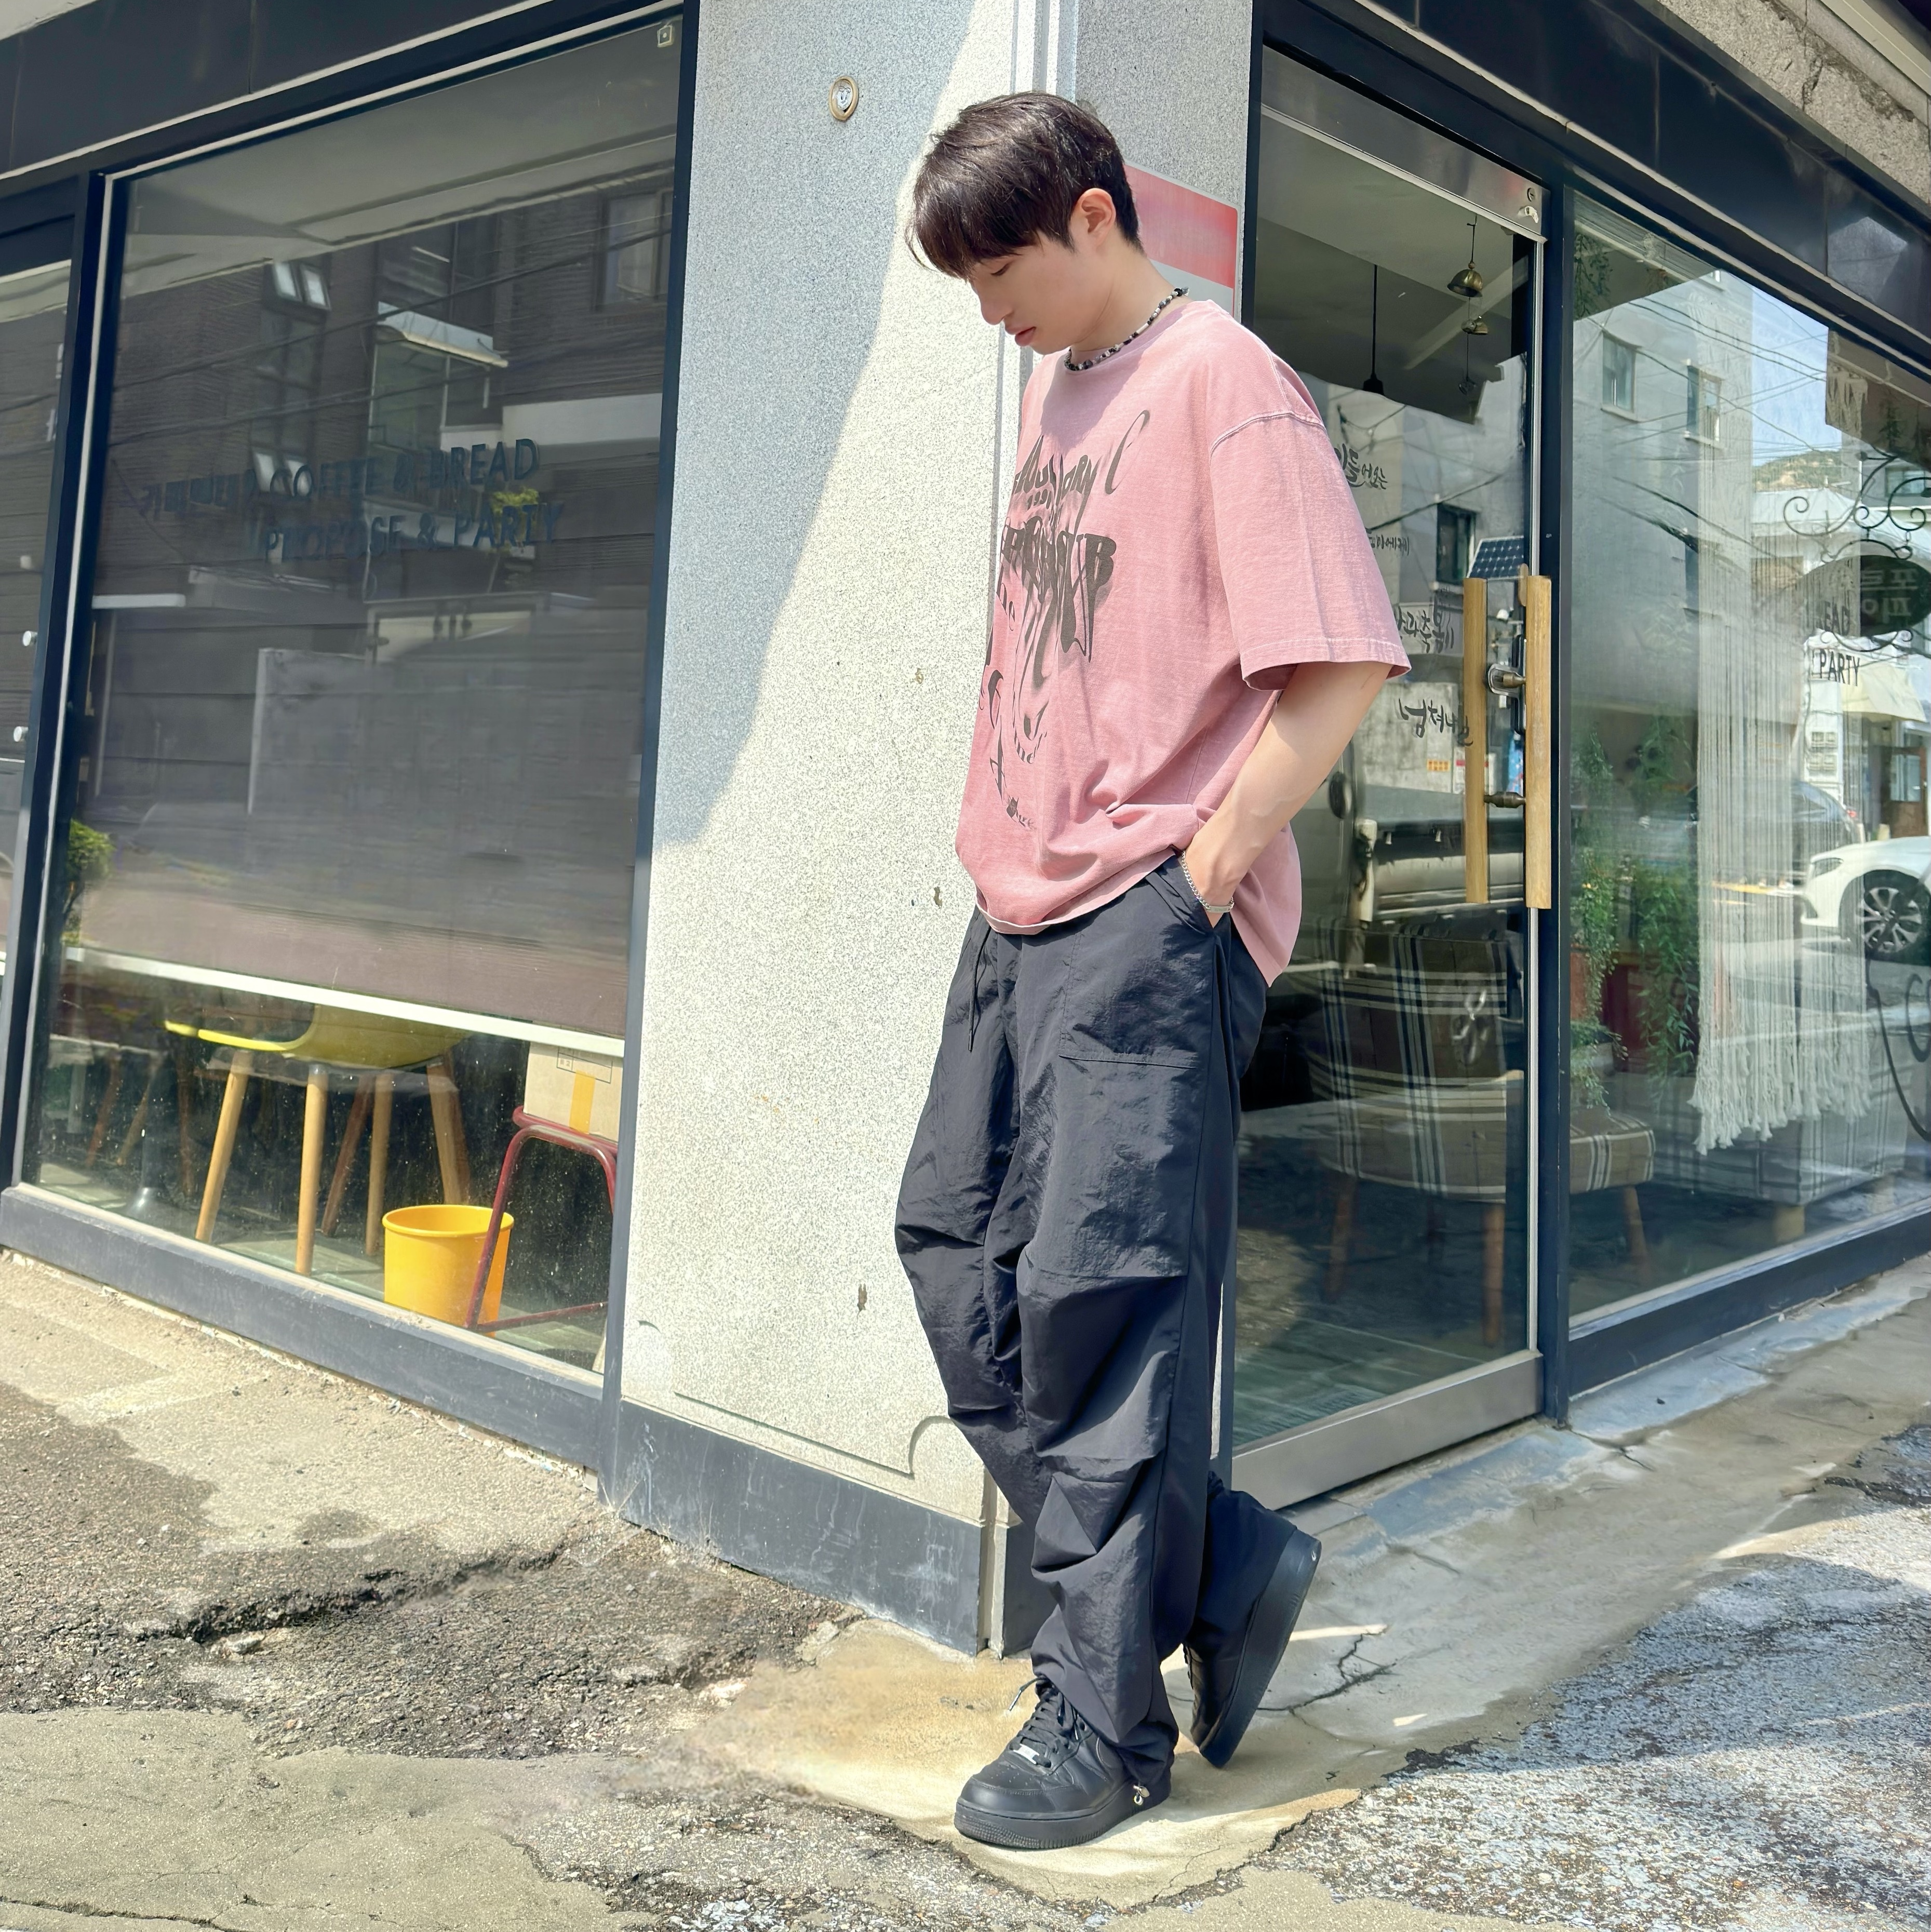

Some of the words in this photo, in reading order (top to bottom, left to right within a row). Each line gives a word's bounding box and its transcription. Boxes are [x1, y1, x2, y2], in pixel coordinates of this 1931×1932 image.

[429, 439, 539, 489] BREAD
[453, 500, 565, 547] PARTY
[1820, 649, 1860, 687] PARTY
